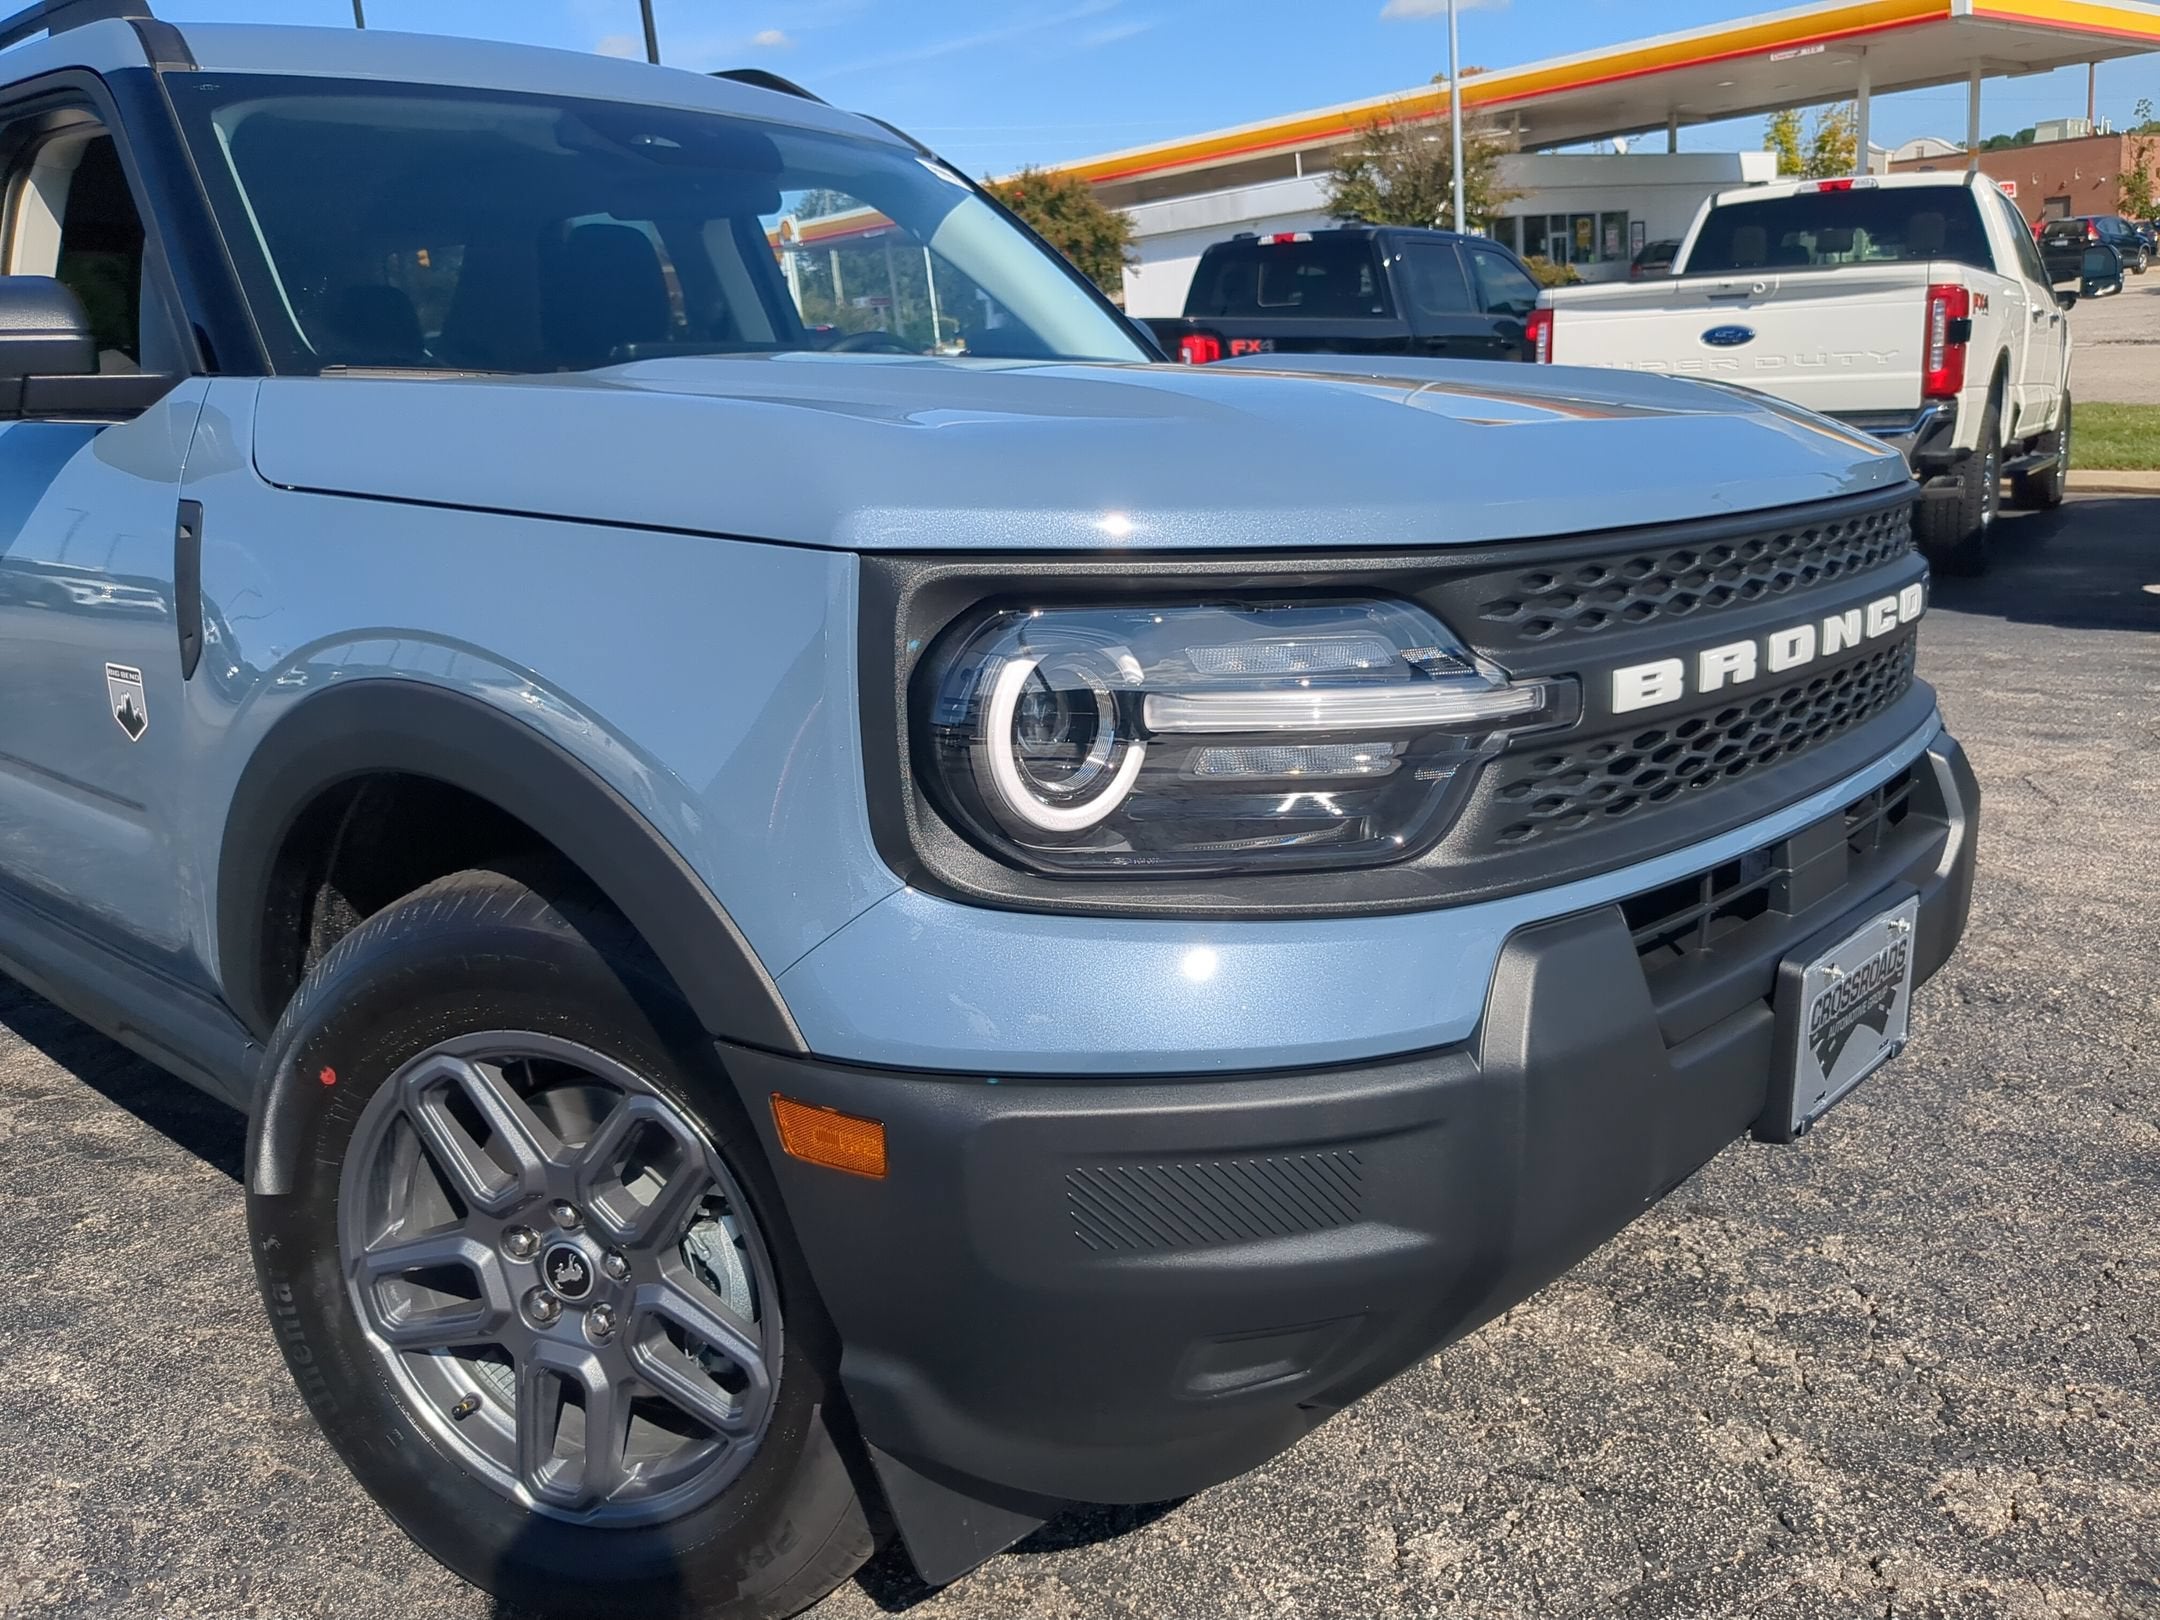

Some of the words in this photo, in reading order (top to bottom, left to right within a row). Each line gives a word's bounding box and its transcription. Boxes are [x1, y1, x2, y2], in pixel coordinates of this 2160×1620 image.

[1755, 350, 1900, 369] DUTY
[108, 668, 120, 677] BIG
[120, 671, 140, 680] BEND
[1612, 582, 1923, 714] BRONCO
[1810, 938, 1907, 1031] CROSSROADS
